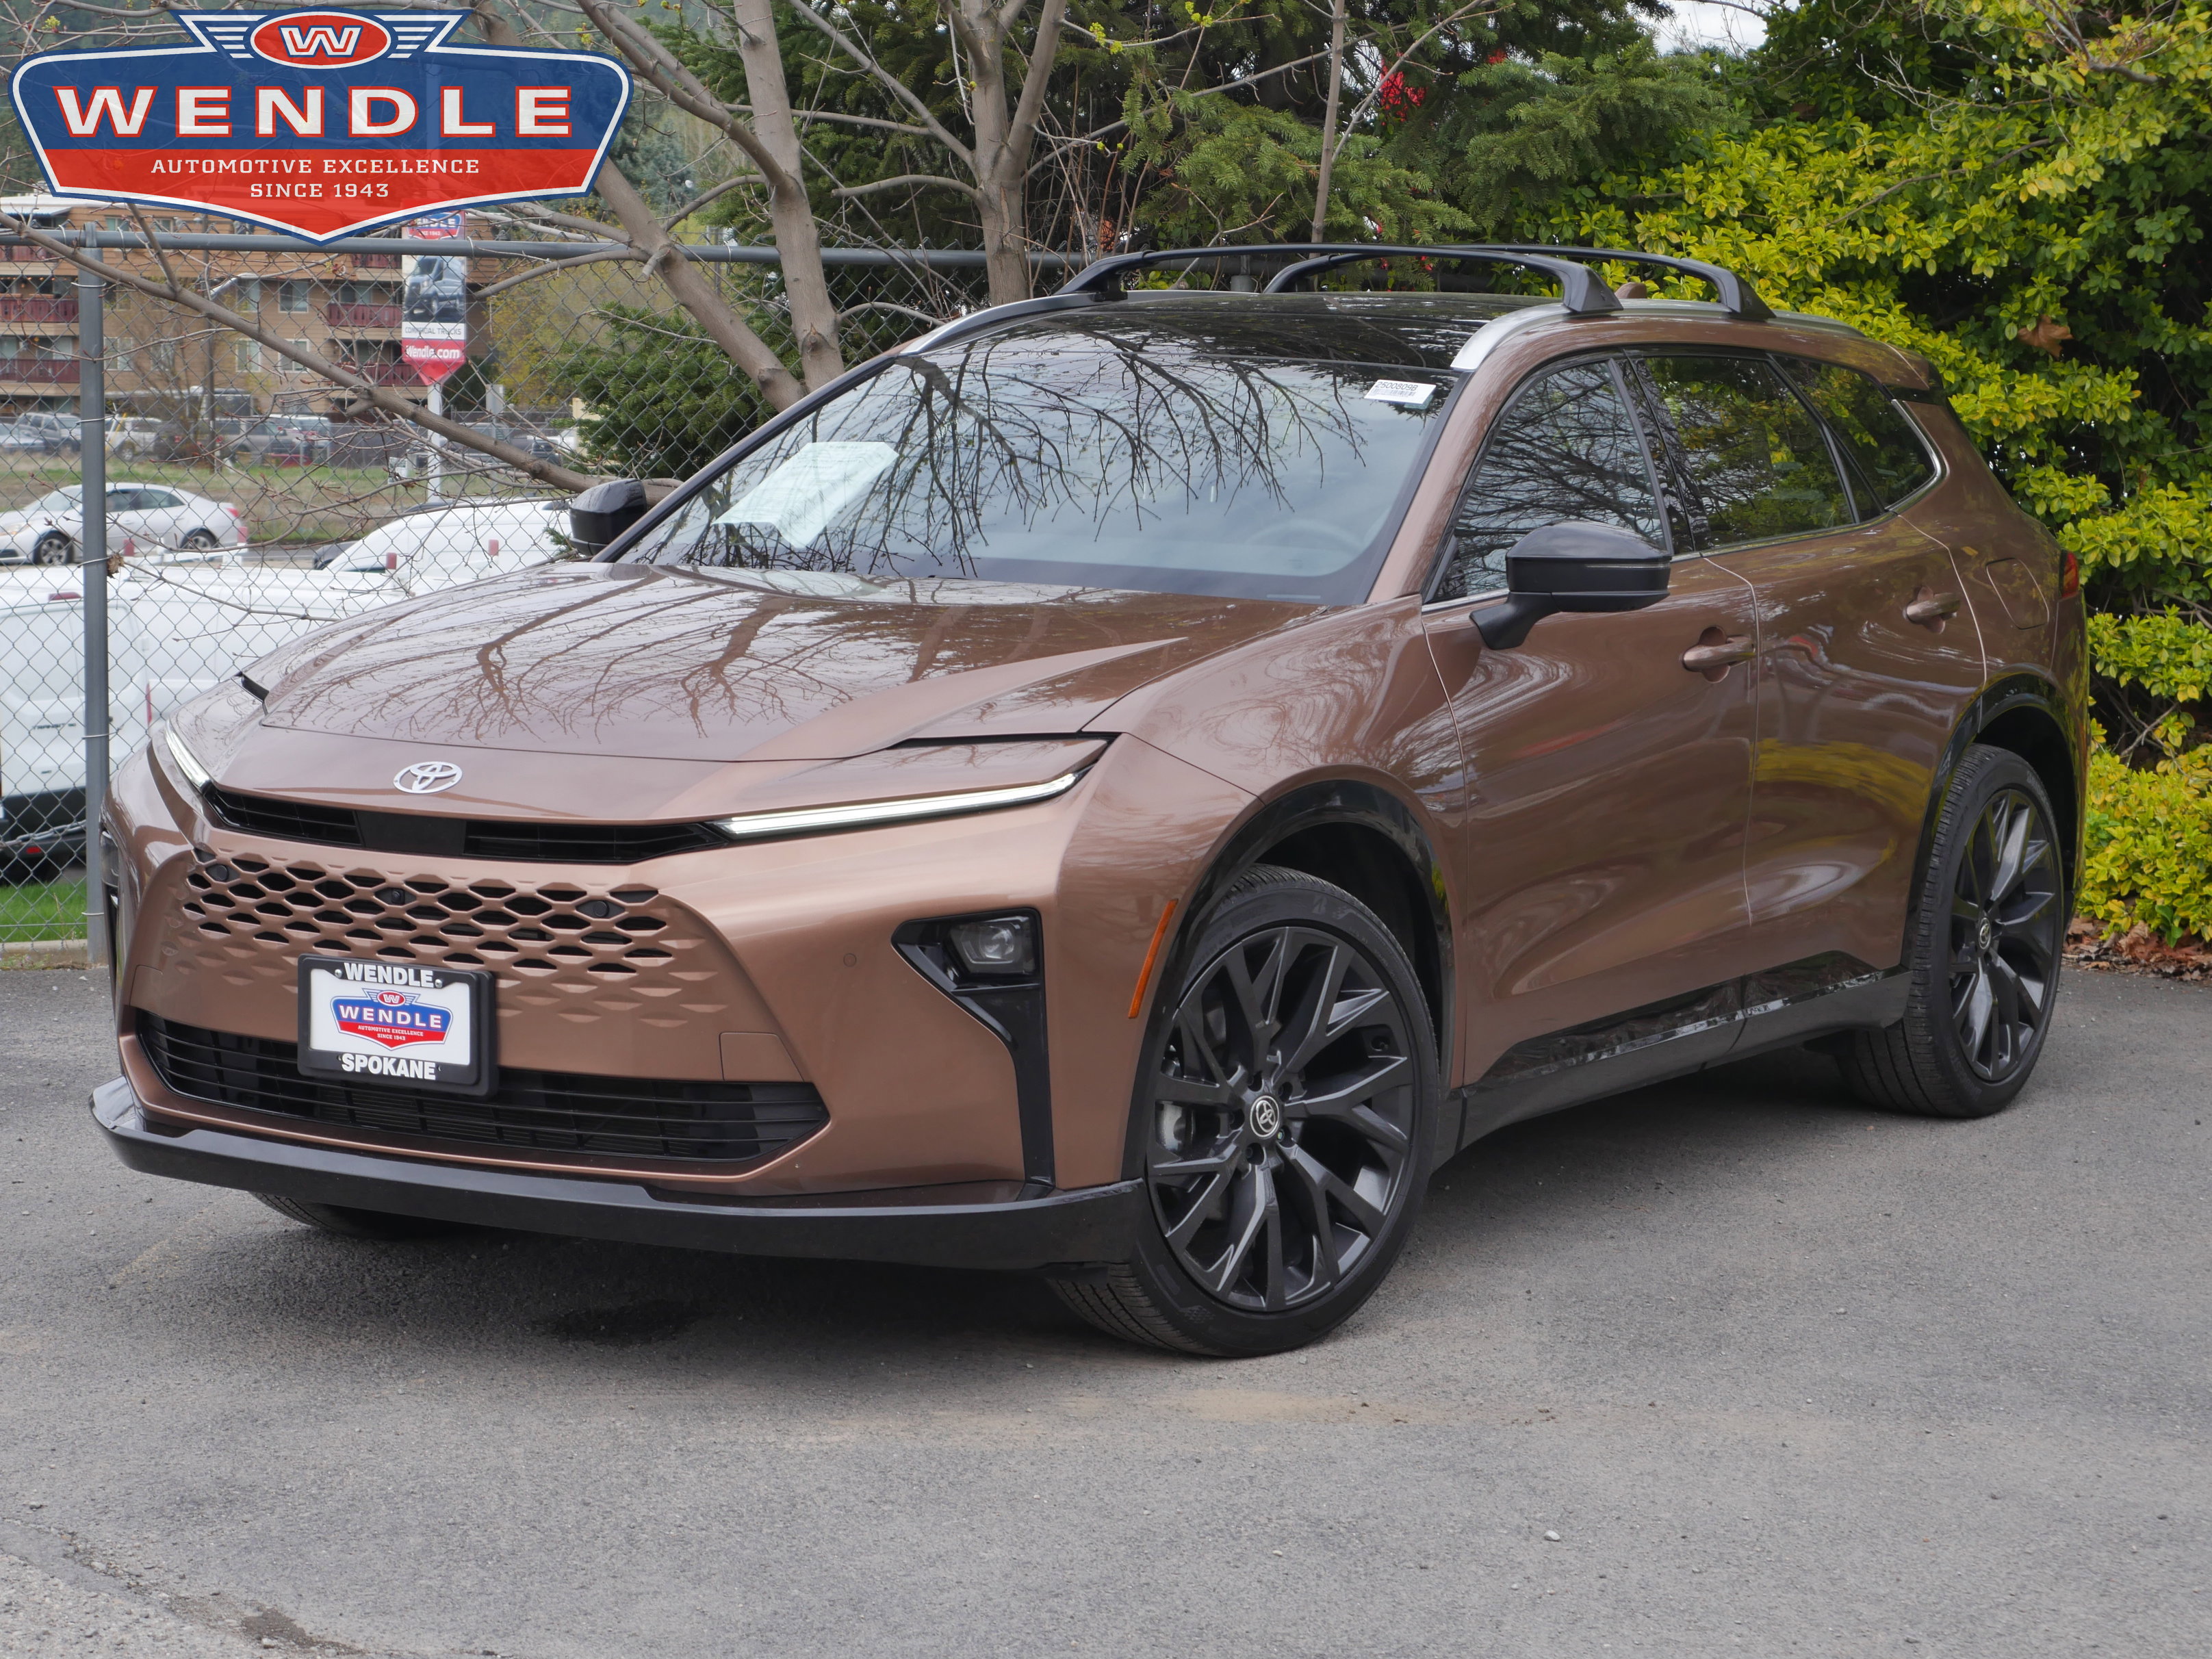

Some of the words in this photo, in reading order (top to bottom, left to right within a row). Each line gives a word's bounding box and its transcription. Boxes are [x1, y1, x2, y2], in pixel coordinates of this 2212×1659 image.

[1375, 381, 1418, 391] 2500809B
[344, 962, 435, 988] WENDLE
[339, 1005, 442, 1028] WENDLE
[358, 1025, 391, 1033] AUTOMOTIVE
[391, 1029, 424, 1037] EXCELLENCE
[342, 1053, 436, 1080] SPOKANE
